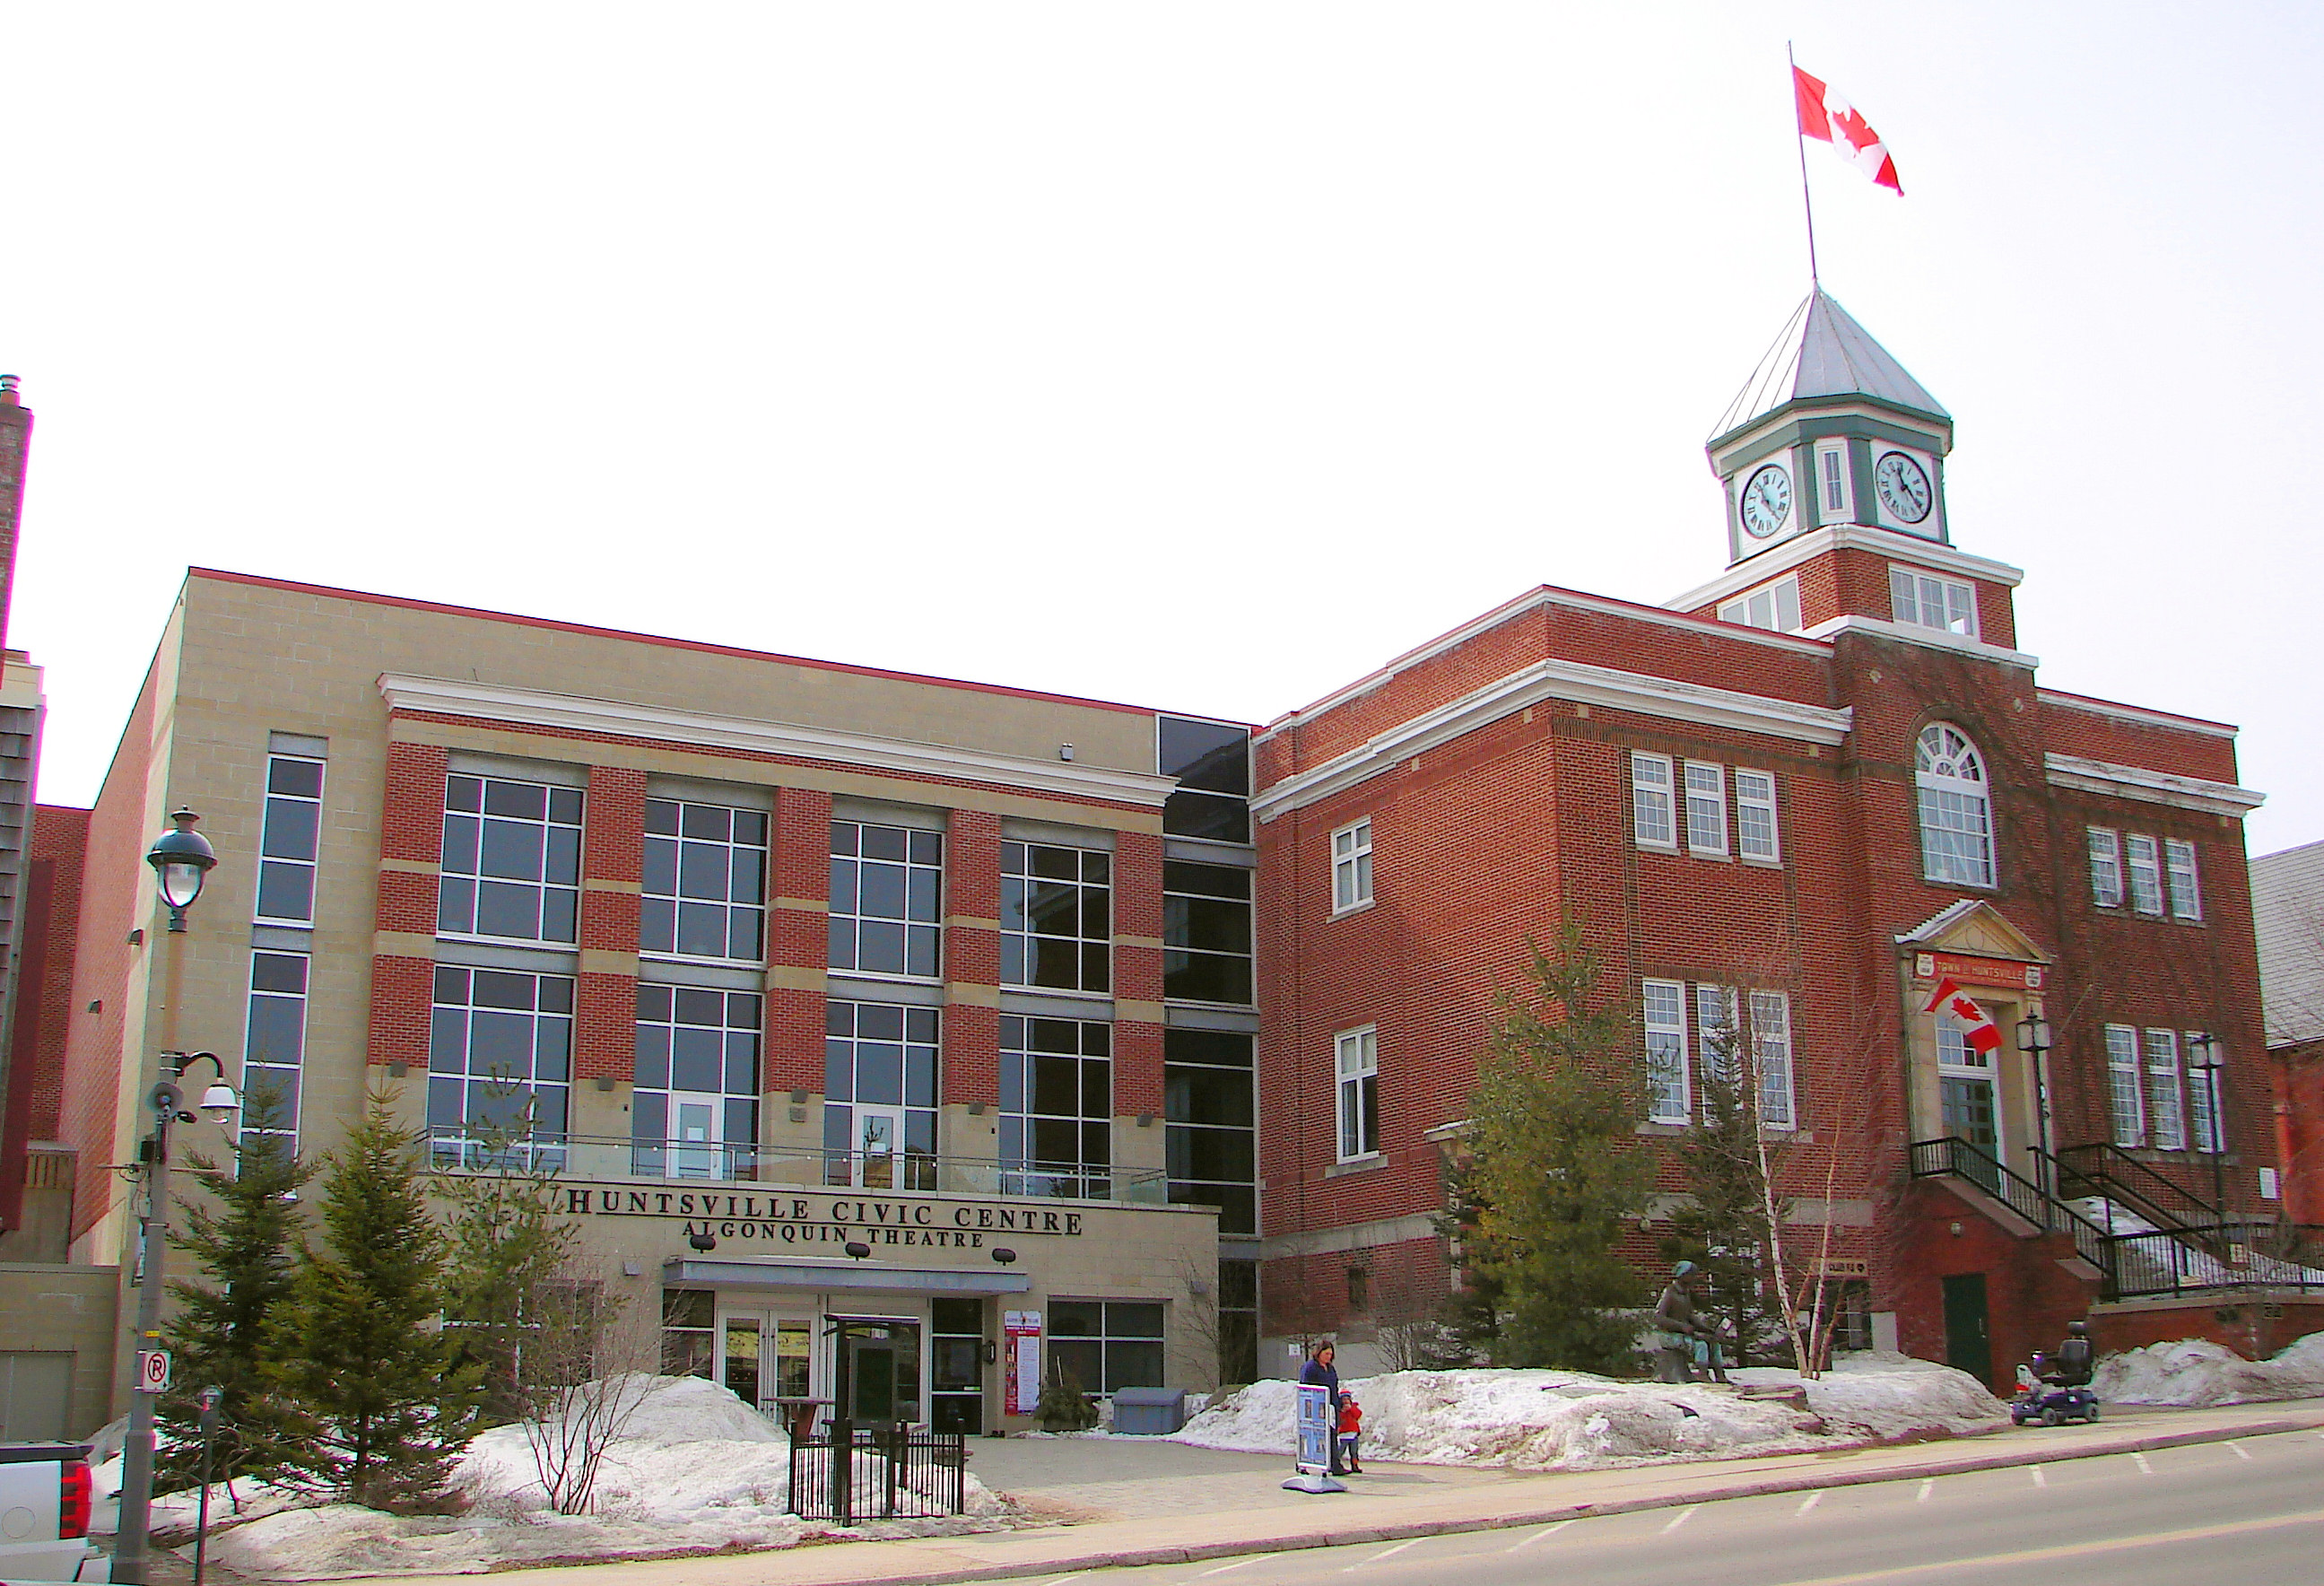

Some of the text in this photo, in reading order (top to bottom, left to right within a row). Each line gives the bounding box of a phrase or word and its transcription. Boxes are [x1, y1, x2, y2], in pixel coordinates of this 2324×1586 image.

[1971, 965, 2024, 980] HUNTSVILLE
[566, 1189, 1083, 1236] HUNTSVILLE CIVIC CENTRE
[682, 1220, 983, 1248] ALGONQUIN THEATRE
